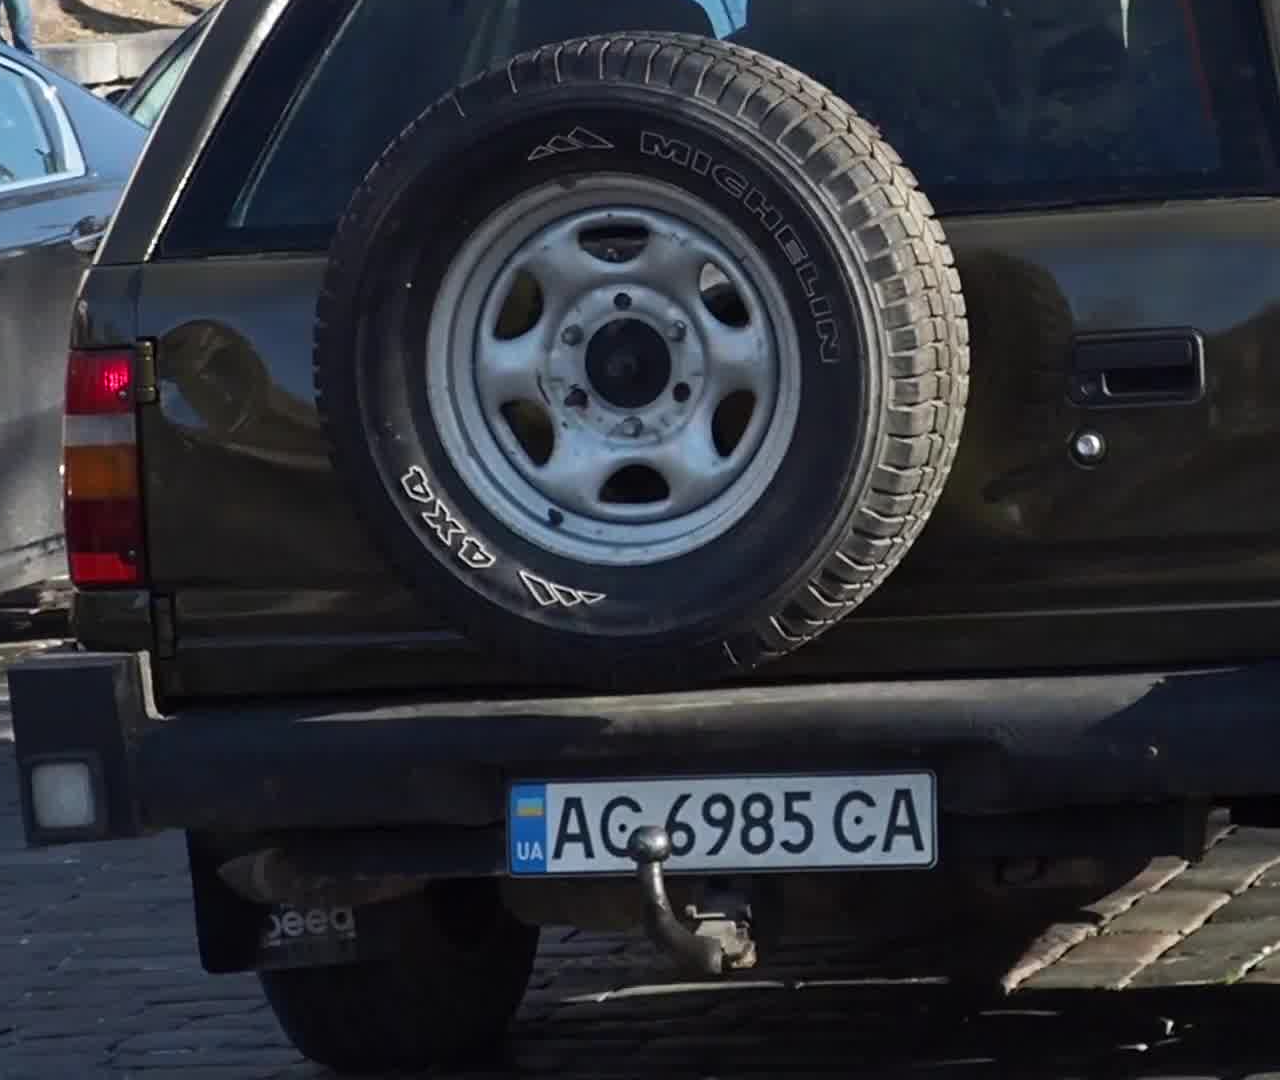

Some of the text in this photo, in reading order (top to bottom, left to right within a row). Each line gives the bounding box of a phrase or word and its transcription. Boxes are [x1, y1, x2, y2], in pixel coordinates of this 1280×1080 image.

[640, 130, 841, 364] MICHELIN
[516, 840, 544, 862] UA
[664, 791, 815, 858] 6985
[833, 788, 925, 854] CA
